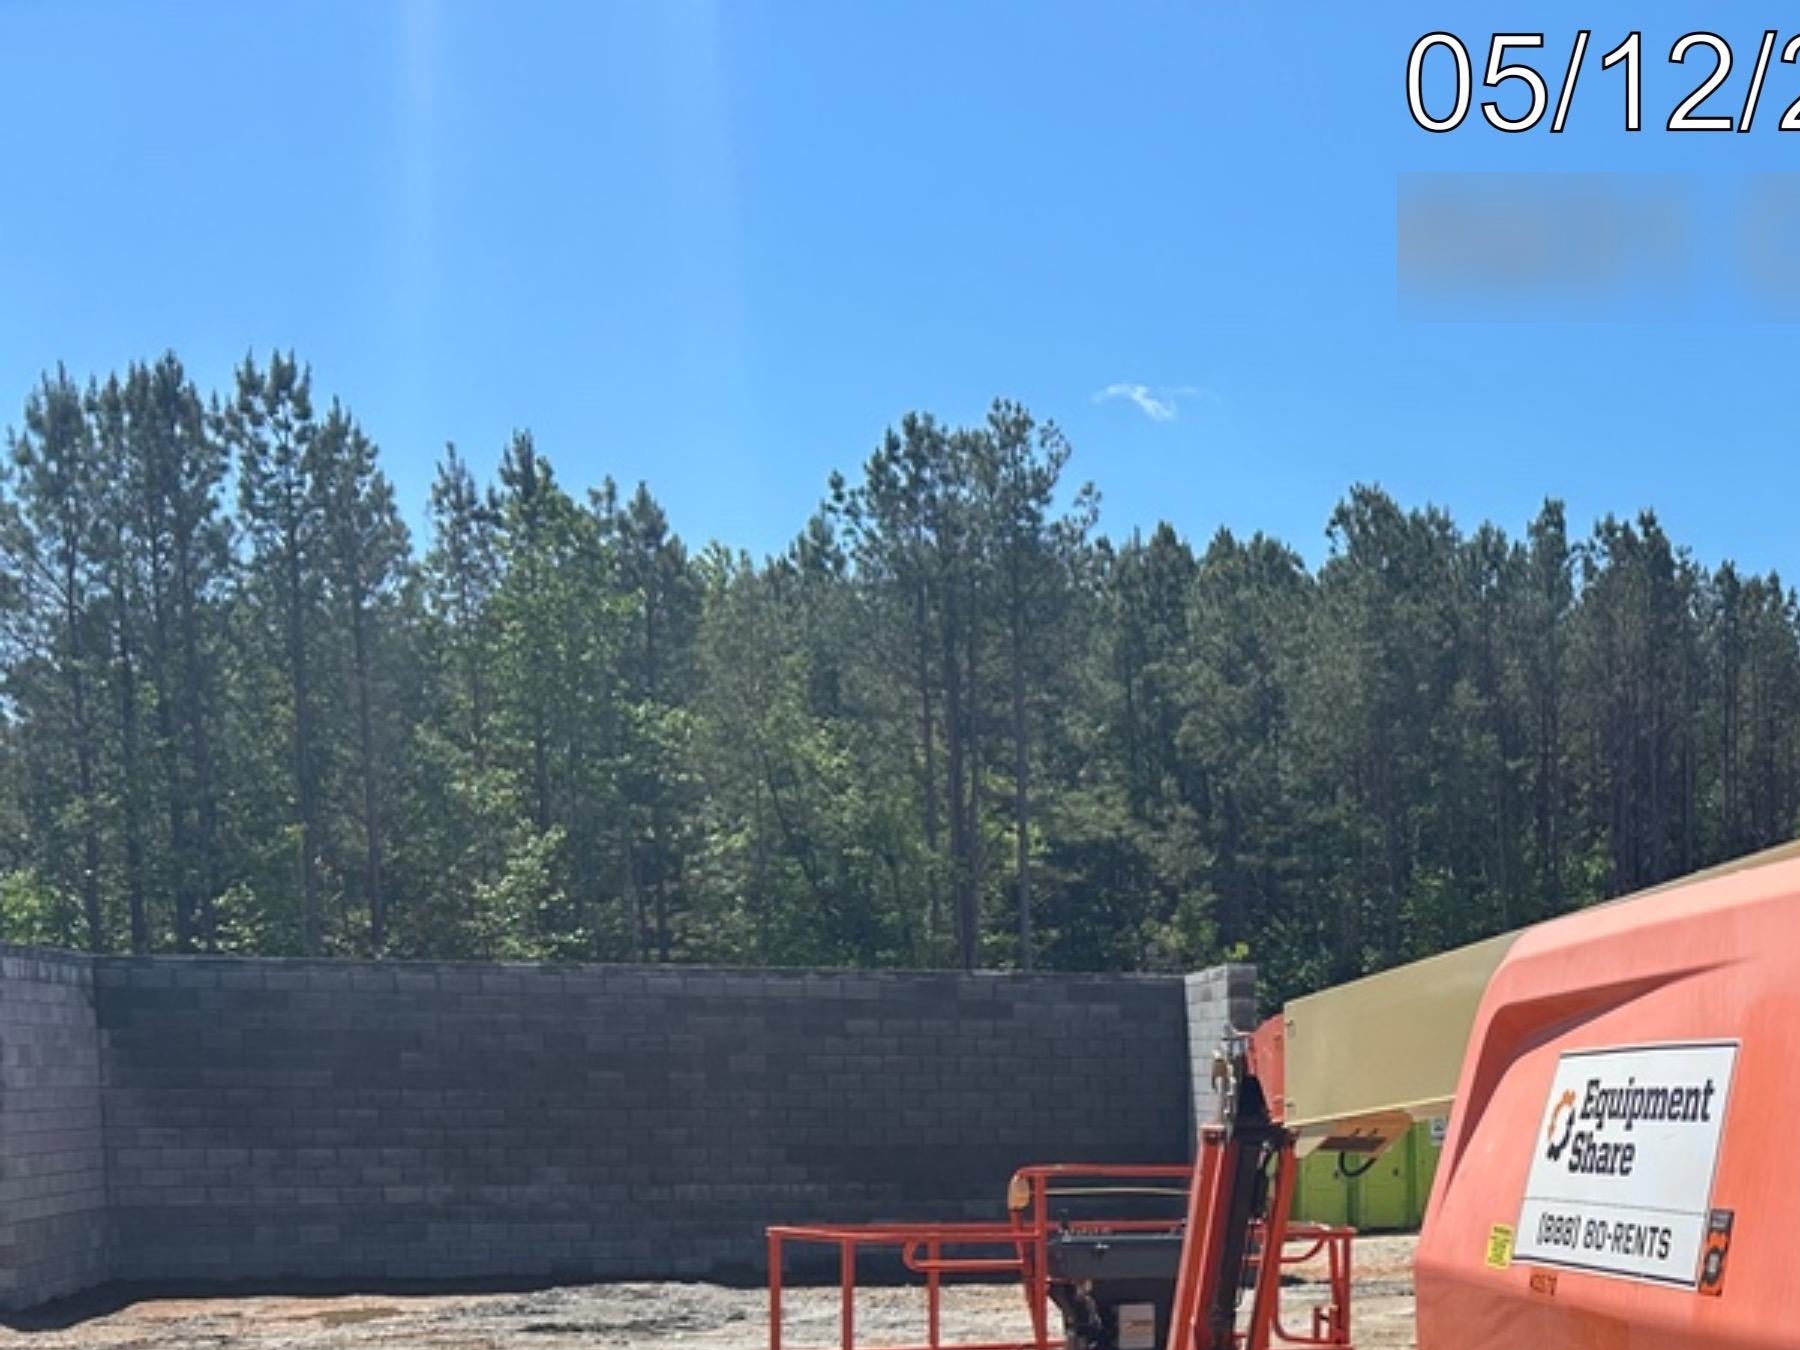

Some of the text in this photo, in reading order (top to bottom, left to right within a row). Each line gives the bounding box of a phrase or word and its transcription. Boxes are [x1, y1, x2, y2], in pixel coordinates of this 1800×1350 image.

[1580, 1077, 1715, 1130] Equipment
[1568, 1130, 1635, 1176] Share
[1536, 1212, 1580, 1250] (888)
[1583, 1219, 1673, 1260] 80-RENTS
